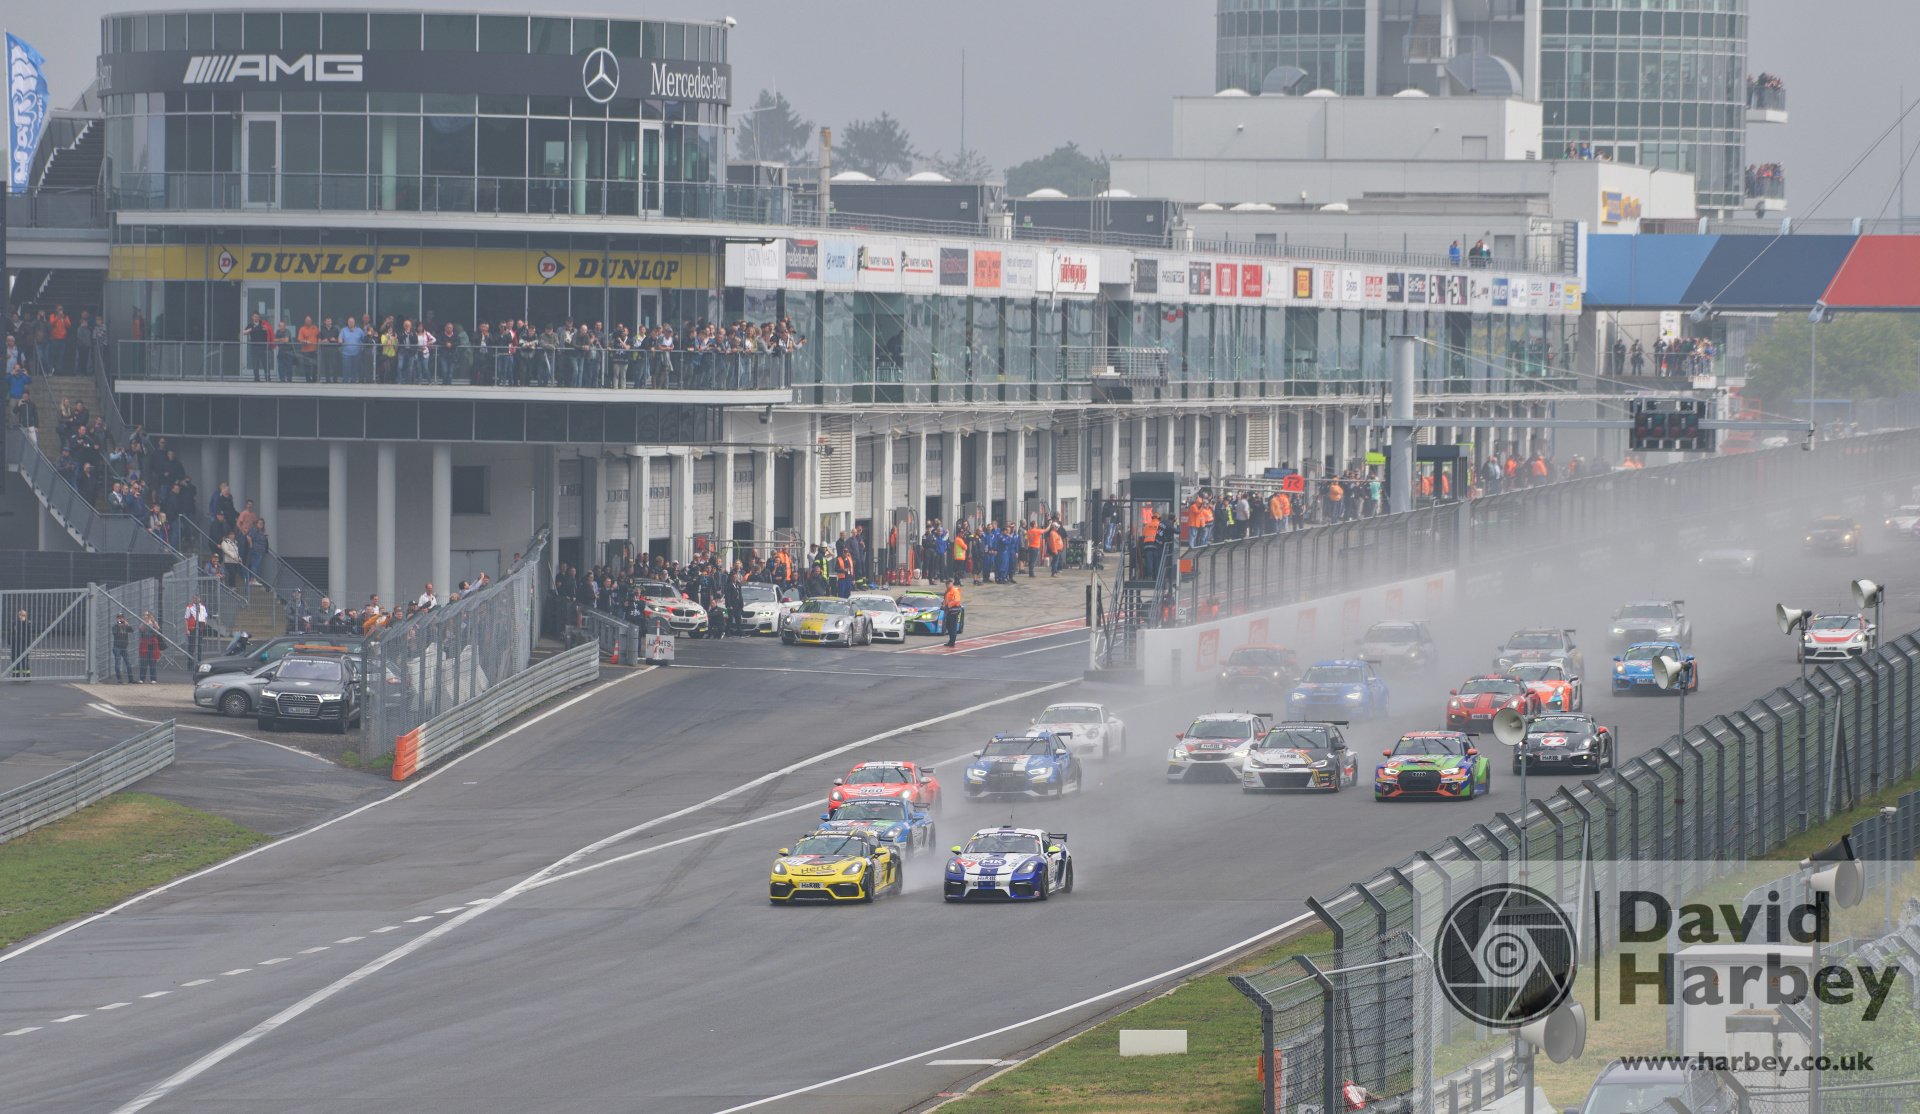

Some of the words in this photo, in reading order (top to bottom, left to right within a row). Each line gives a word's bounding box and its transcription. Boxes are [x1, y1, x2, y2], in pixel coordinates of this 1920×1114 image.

[226, 54, 363, 82] AMG
[650, 62, 727, 100] Mercedes-Benz
[246, 252, 411, 275] DUNLOP
[574, 258, 679, 281] DUNLOP
